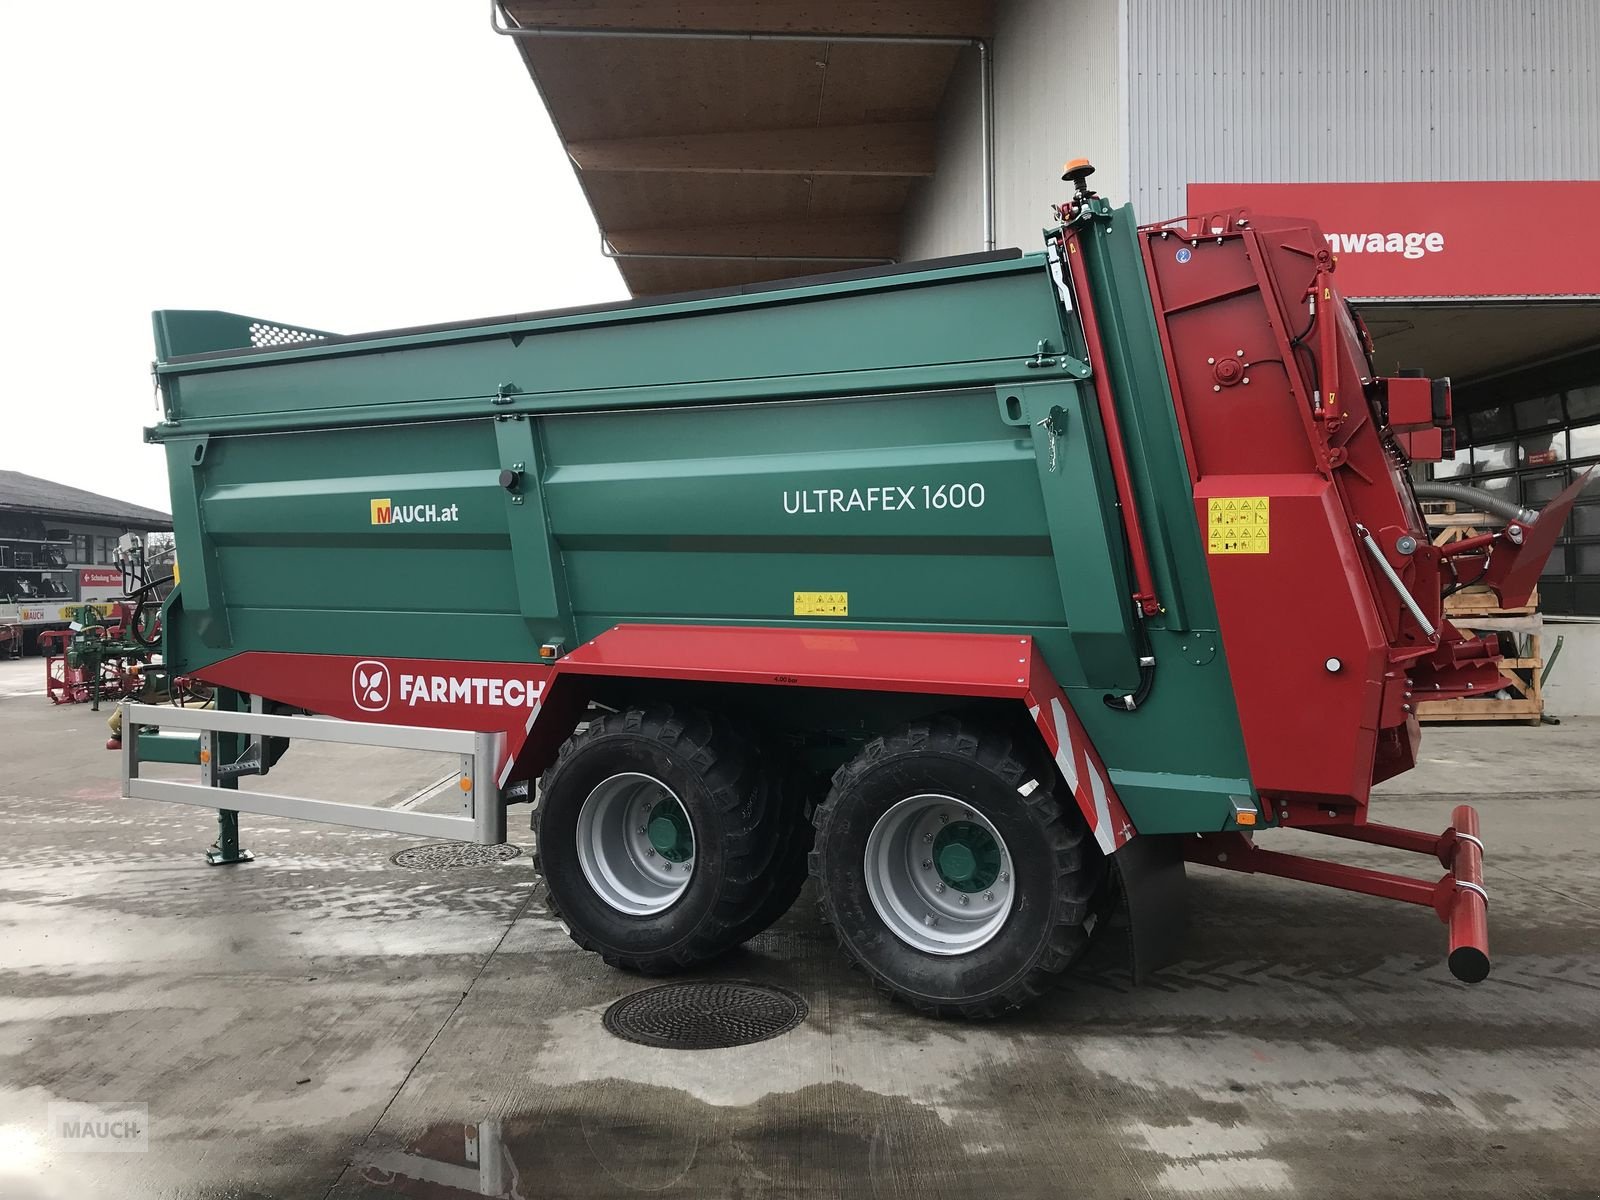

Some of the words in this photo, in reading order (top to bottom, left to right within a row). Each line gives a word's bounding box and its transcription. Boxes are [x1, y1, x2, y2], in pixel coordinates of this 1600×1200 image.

[1323, 231, 1444, 260] nwaage
[783, 485, 916, 514] ULTRAFEX
[922, 482, 986, 509] 1600
[376, 503, 459, 524] MAUCH.at
[400, 674, 546, 707] FARMTECH
